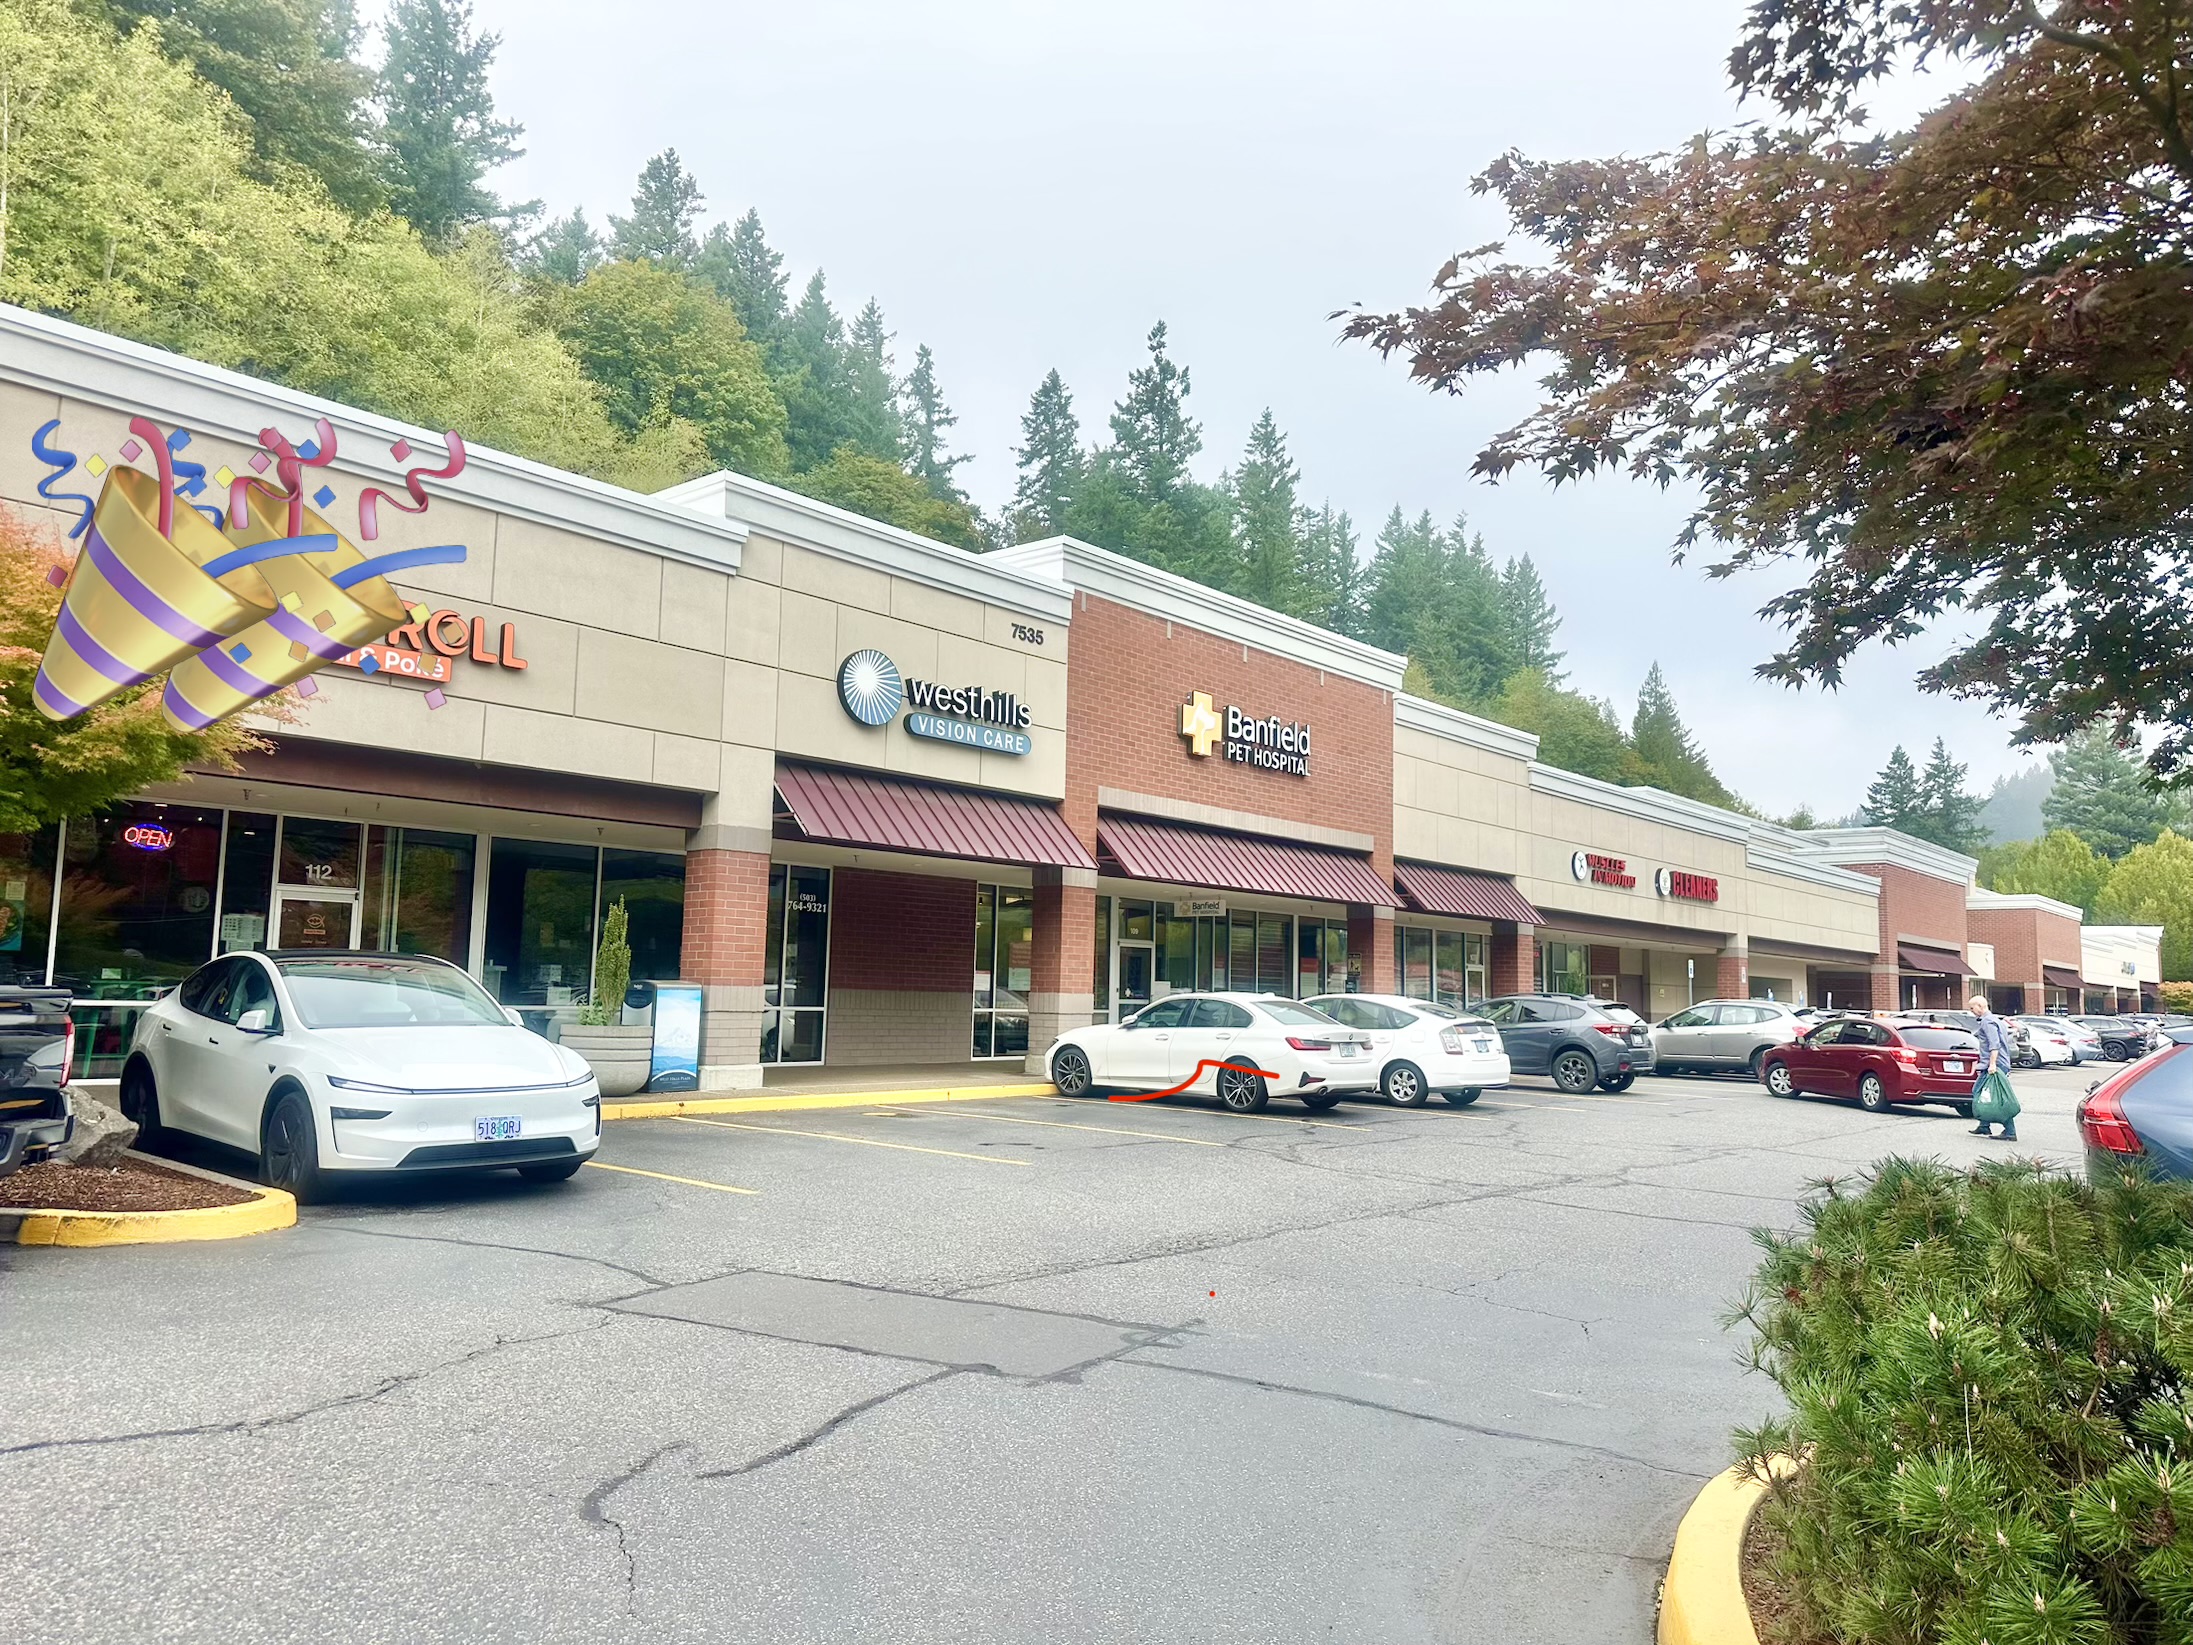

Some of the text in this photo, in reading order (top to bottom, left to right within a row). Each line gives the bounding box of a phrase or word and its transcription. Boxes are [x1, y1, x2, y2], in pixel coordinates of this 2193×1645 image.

[386, 600, 529, 671] ROLL
[1011, 622, 1044, 646] 7535
[905, 677, 1033, 729] westhills
[918, 715, 1025, 752] VISION CARE
[1226, 704, 1311, 757] Banfield
[1226, 741, 1312, 777] PET HOSPITAL
[124, 826, 173, 848] OPEN
[305, 864, 332, 880] 112
[800, 893, 816, 902] (503)
[1671, 870, 1719, 903] CLEANERS
[787, 900, 827, 913] 764-9321
[1192, 901, 1220, 910] Banfield
[478, 1121, 497, 1136] 518
